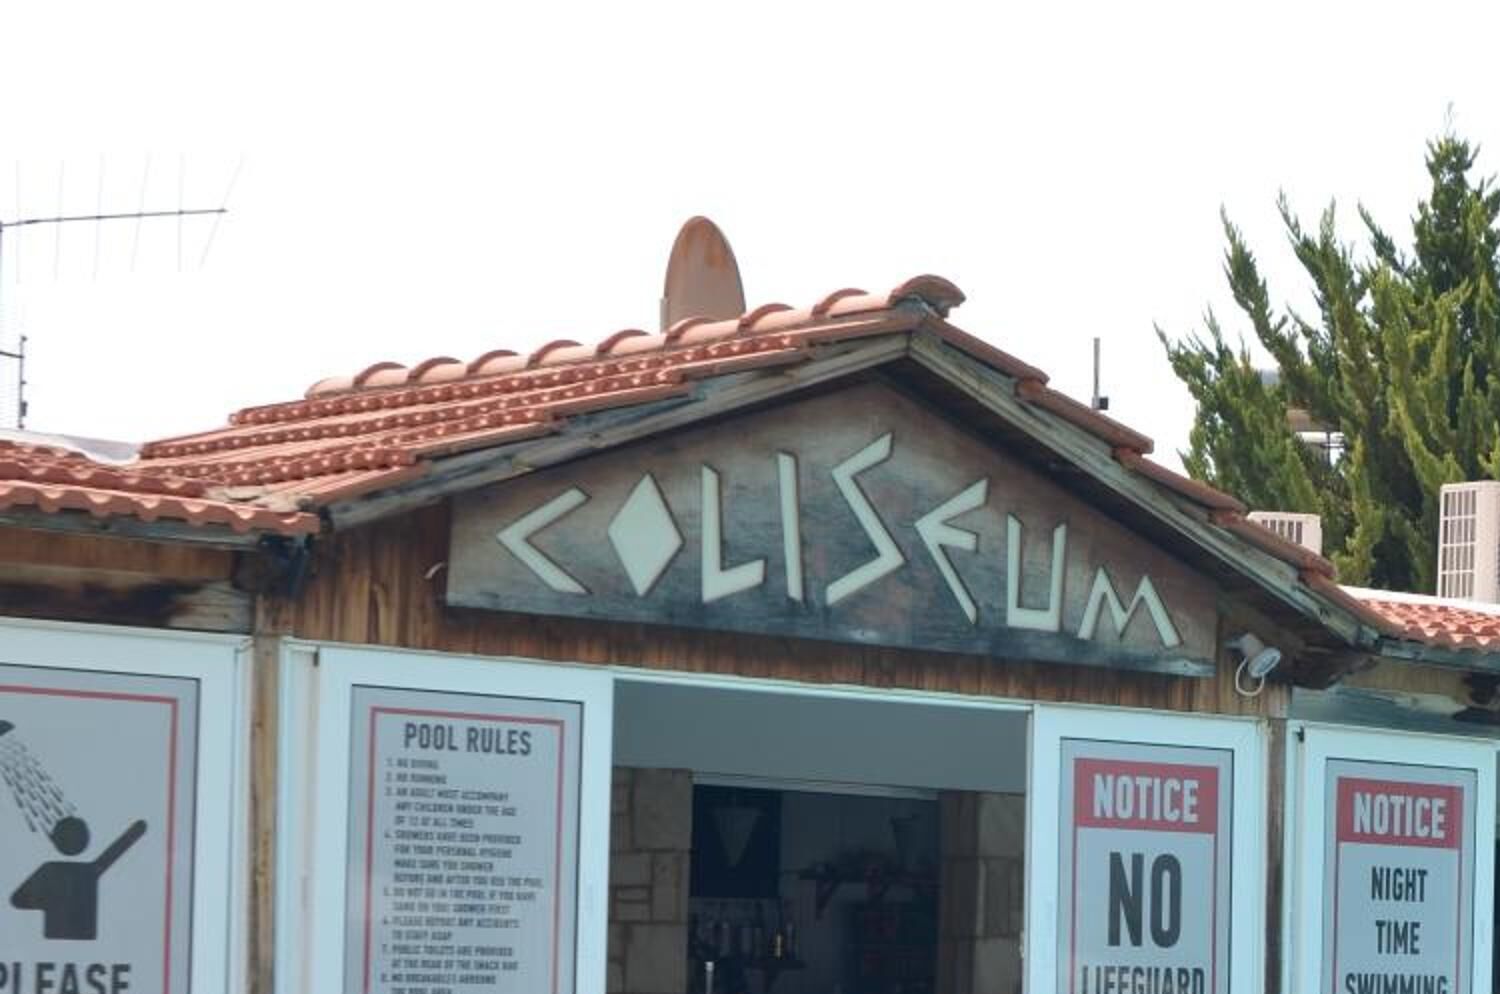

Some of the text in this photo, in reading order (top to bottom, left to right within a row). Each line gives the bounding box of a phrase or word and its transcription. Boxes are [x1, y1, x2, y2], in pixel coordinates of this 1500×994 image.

[496, 431, 1183, 649] COLISEUM
[404, 723, 532, 756] POOL RULES
[1093, 773, 1199, 822] NOTICE
[1353, 792, 1446, 840] NOTICE
[1107, 851, 1183, 949] NO
[1371, 866, 1428, 903] NIGHT
[1375, 920, 1420, 955] TIME
